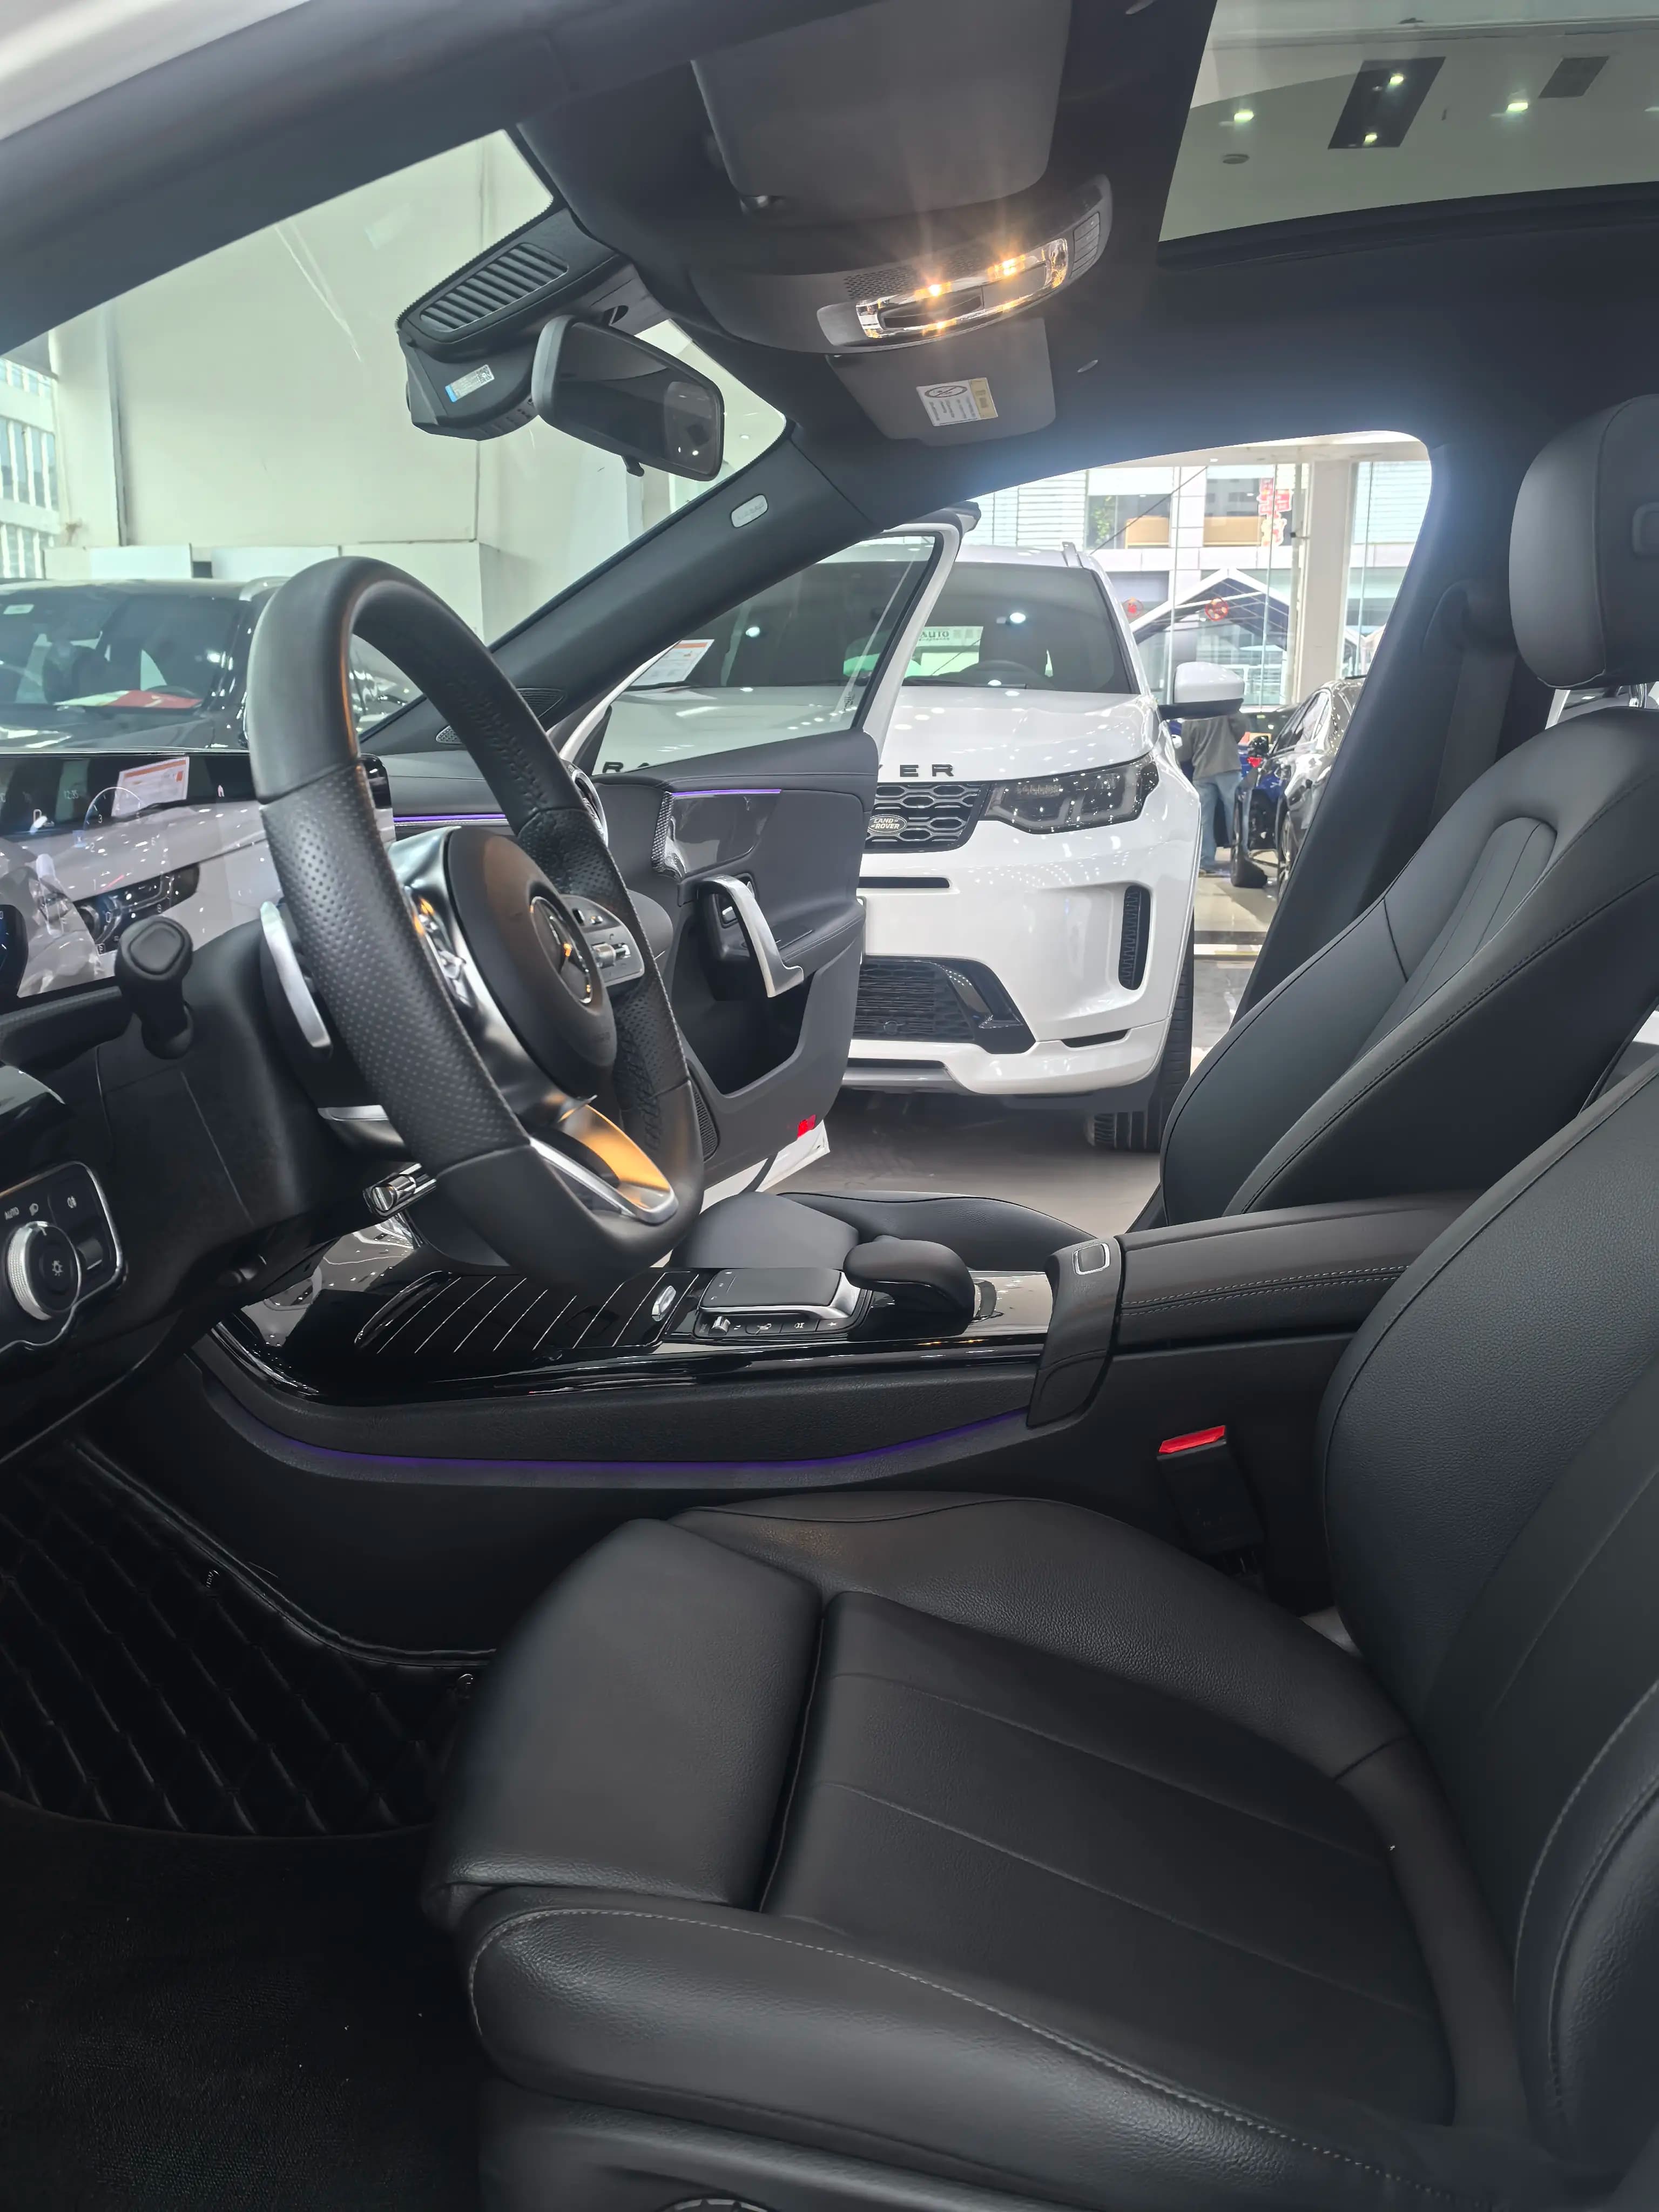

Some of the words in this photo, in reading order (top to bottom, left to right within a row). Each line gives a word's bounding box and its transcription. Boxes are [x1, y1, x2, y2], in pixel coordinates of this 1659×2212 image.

[879, 764, 954, 777] ER
[98, 814, 103, 824] 3
[90, 842, 95, 853] 2
